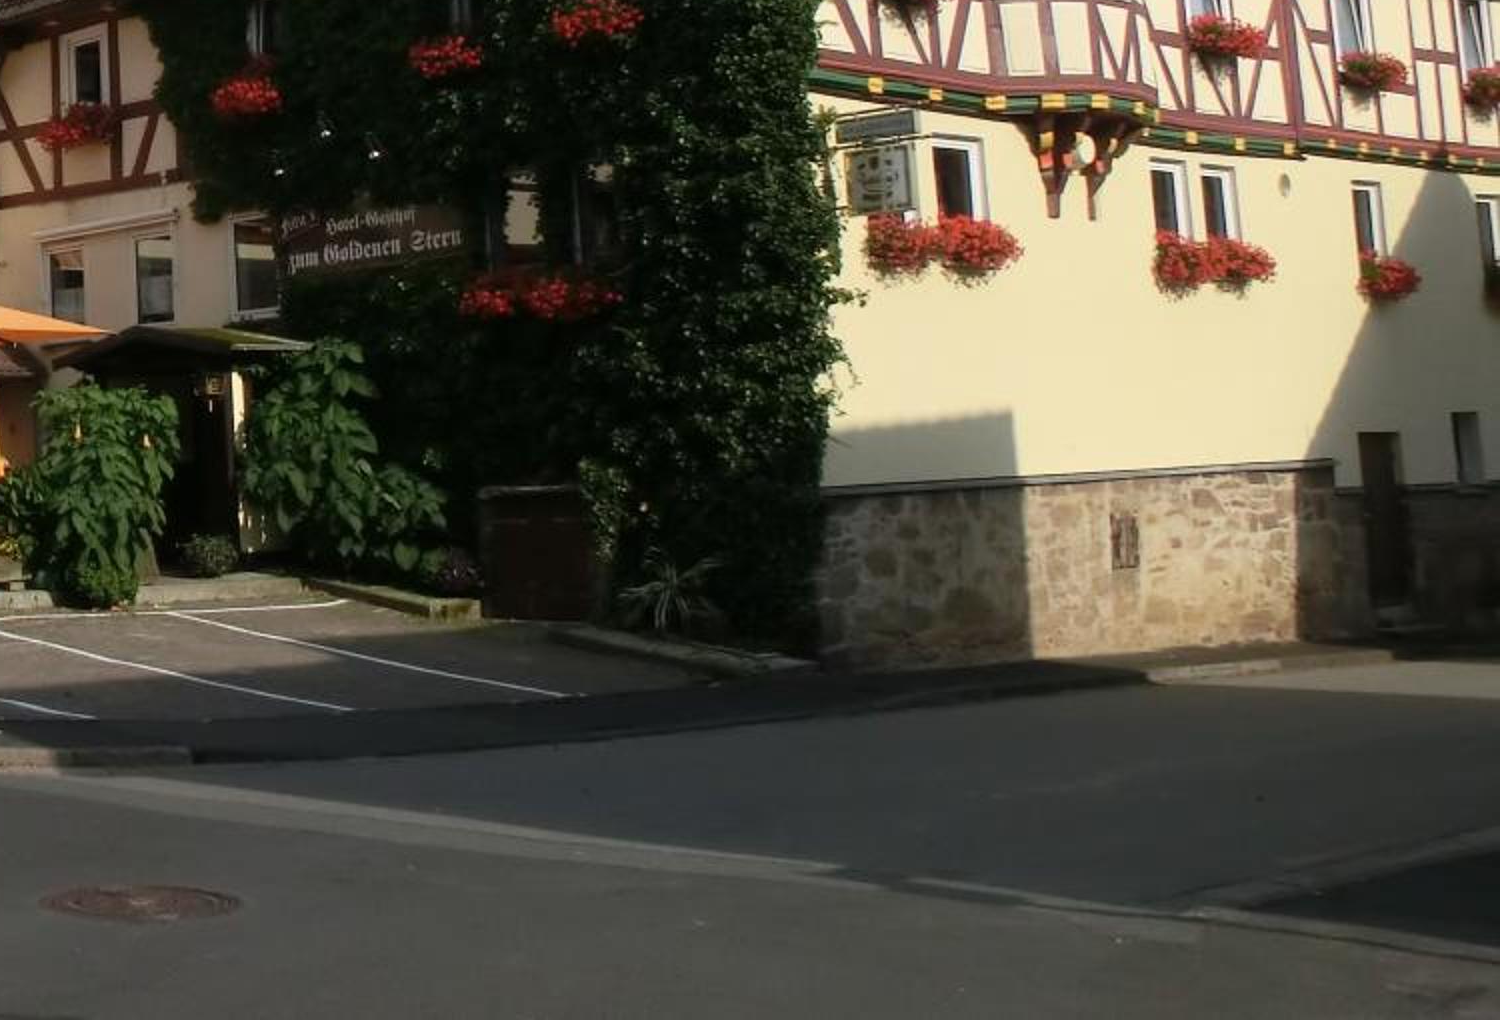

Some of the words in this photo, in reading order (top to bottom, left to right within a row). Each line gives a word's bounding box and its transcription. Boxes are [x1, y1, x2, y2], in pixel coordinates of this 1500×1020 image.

[289, 251, 319, 275] zum
[324, 238, 401, 265] Goldenen
[411, 230, 461, 251] Stern
